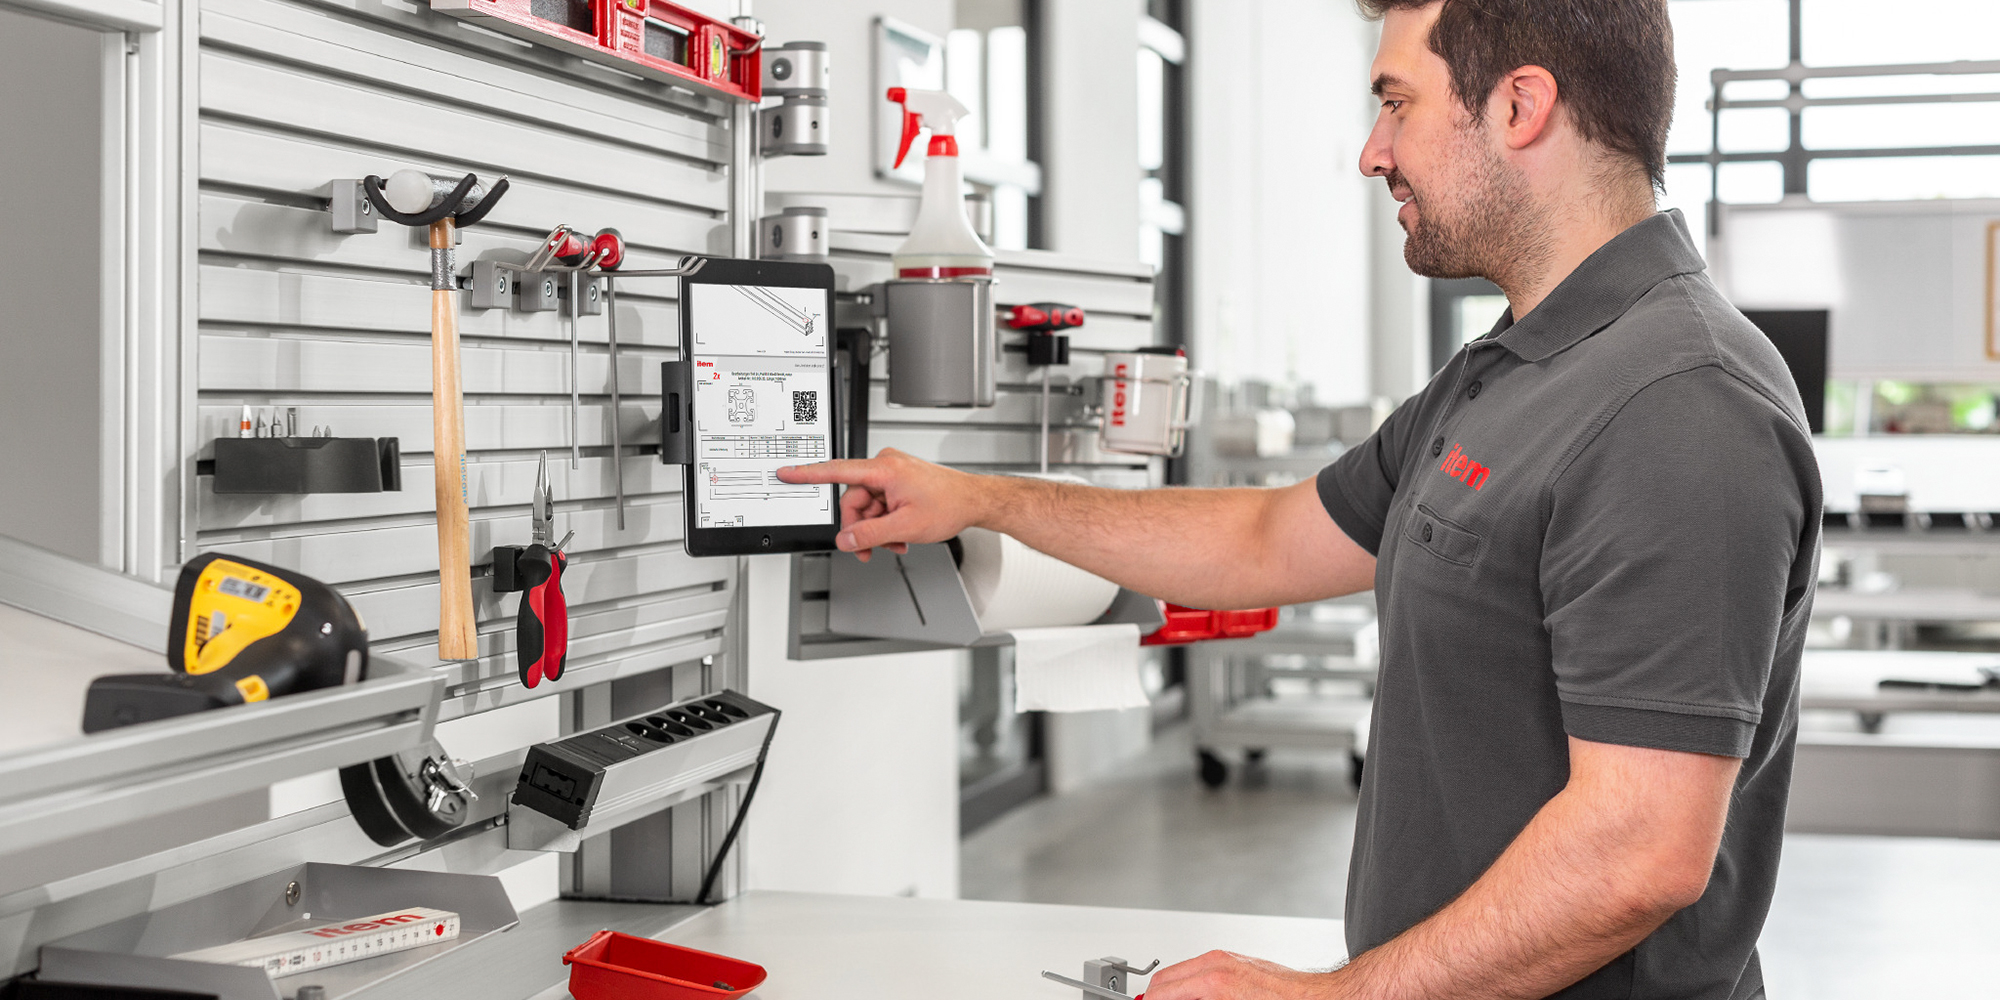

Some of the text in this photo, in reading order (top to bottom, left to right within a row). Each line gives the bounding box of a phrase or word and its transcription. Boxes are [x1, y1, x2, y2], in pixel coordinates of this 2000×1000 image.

[1111, 364, 1127, 426] item
[1440, 443, 1490, 491] item
[302, 914, 426, 938] item
